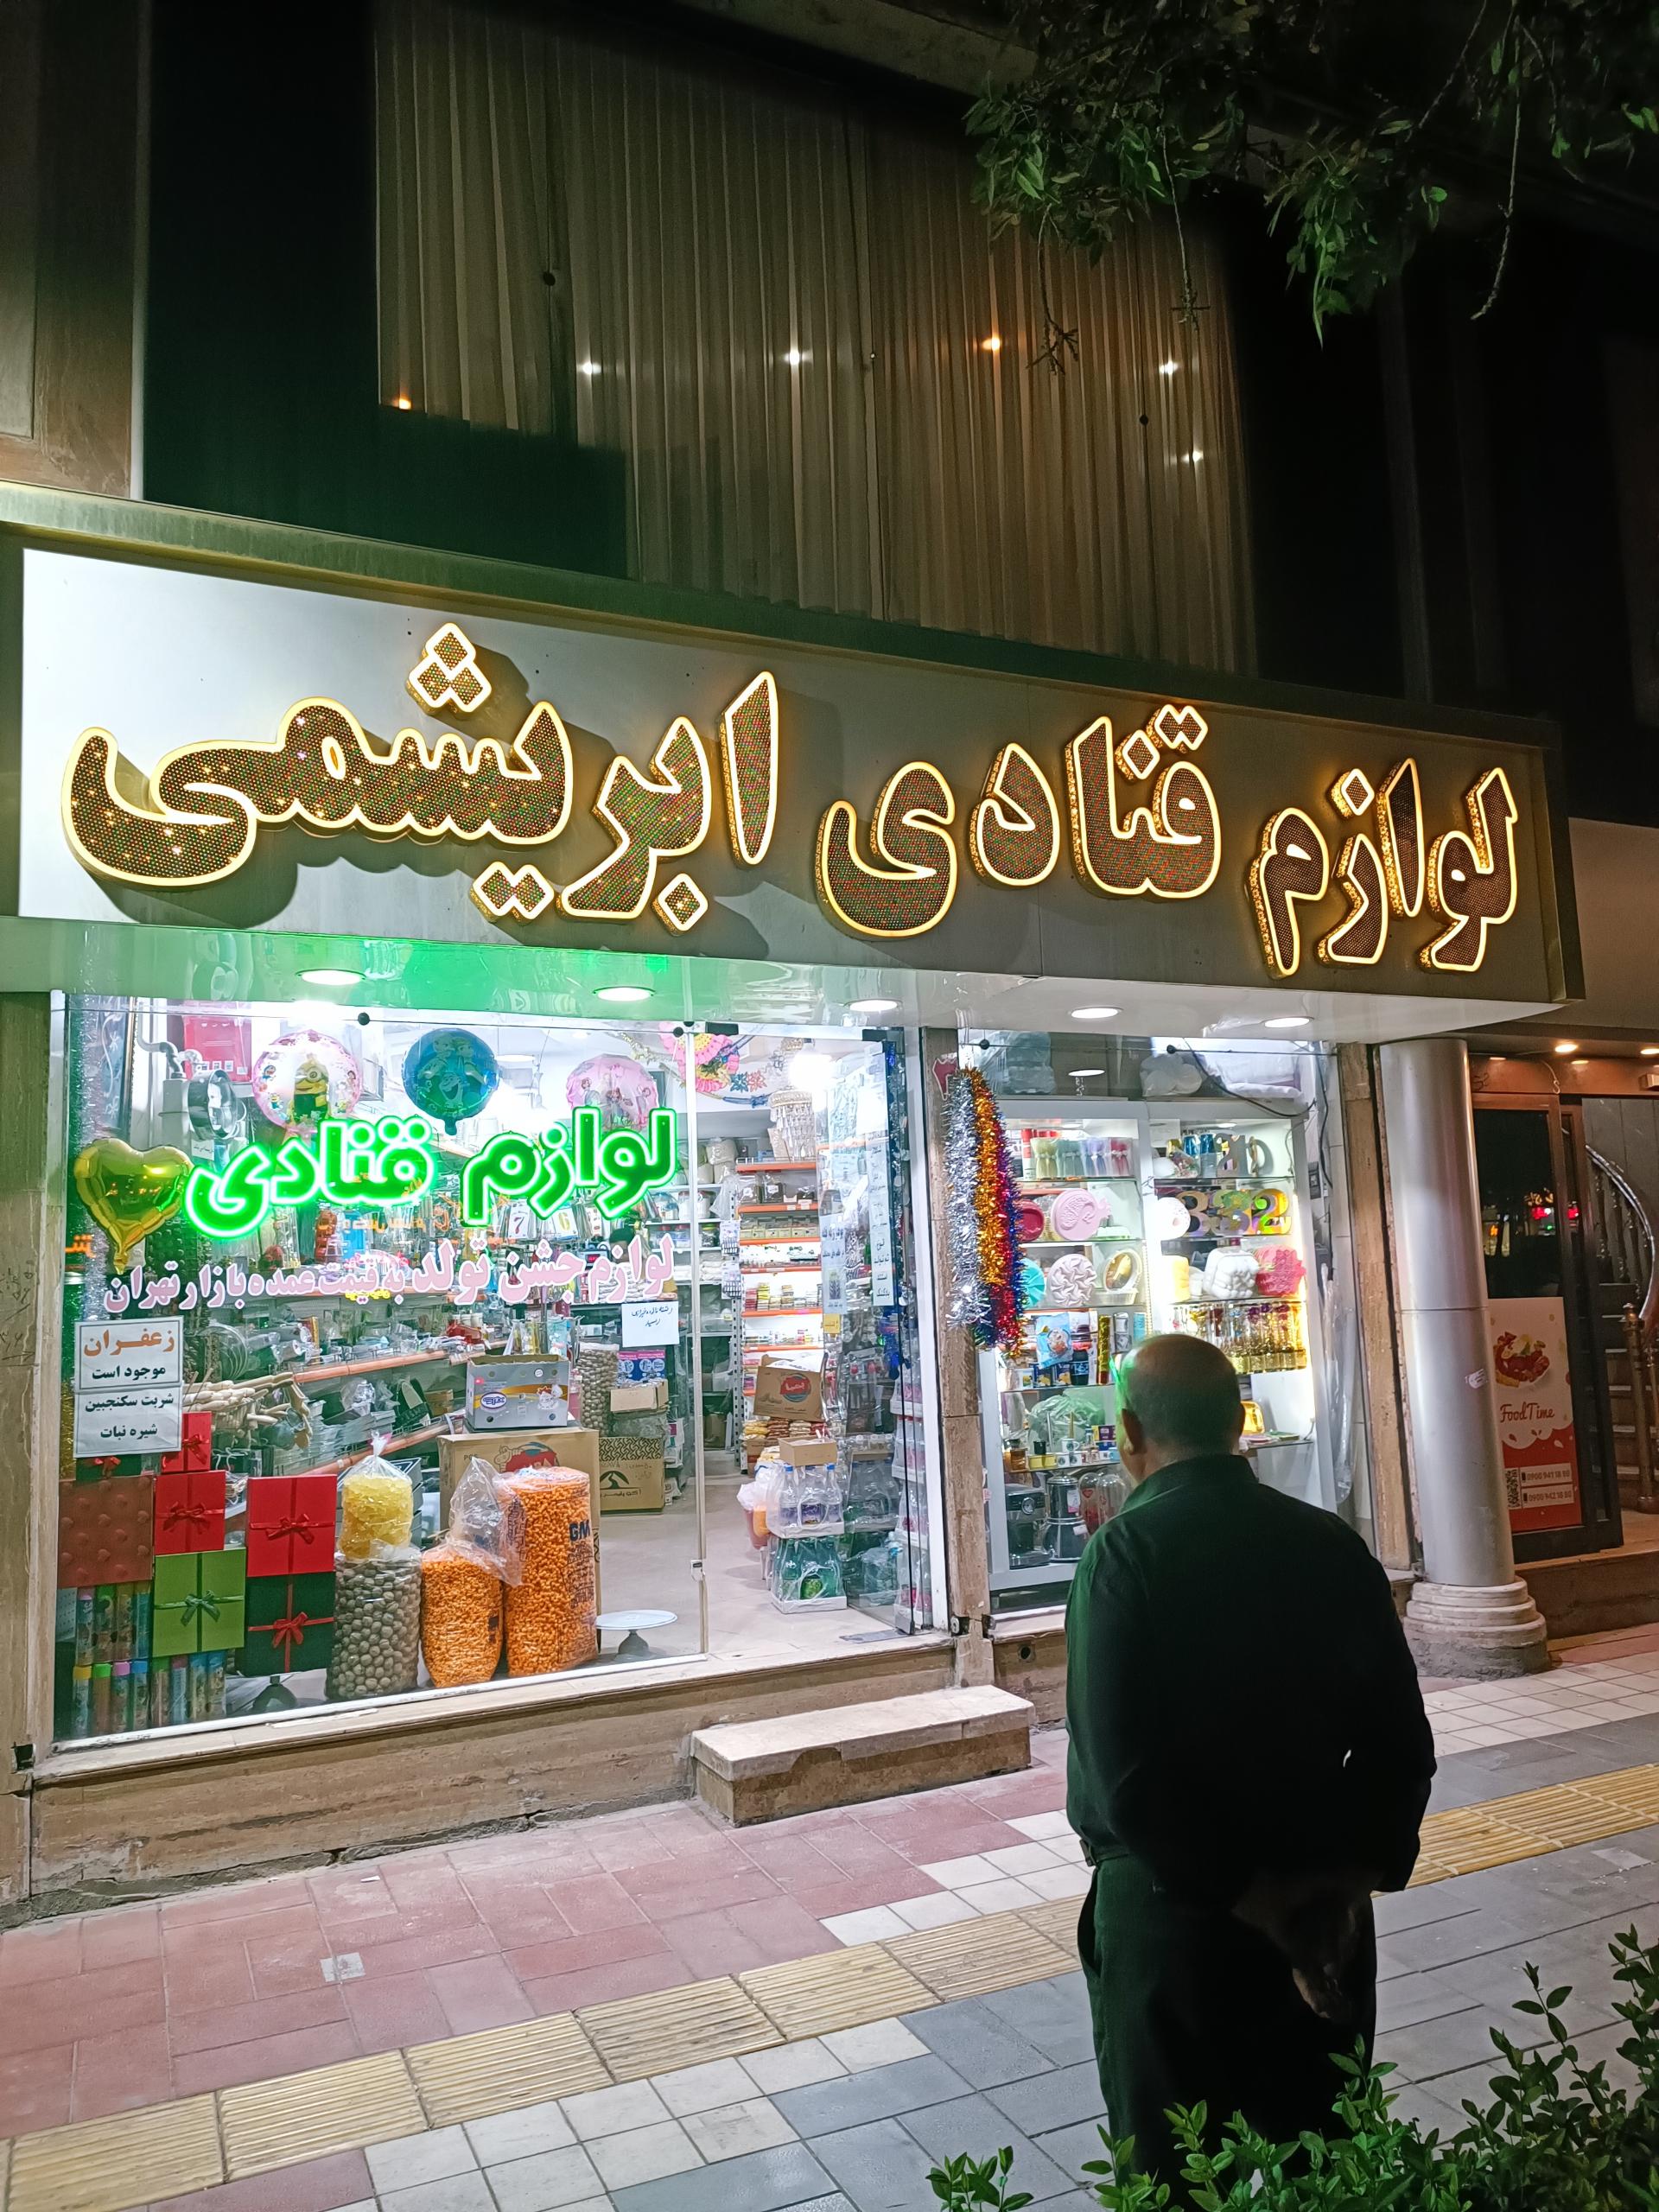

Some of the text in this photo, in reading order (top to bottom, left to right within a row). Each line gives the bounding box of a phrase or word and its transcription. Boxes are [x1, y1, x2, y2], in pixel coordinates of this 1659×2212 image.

[61, 621, 1519, 980] لوازم قنادی ابریشمی
[184, 1106, 677, 1238] لوازم قنادی
[103, 1233, 674, 1313] لوازم جشن تولد به قیمت عمده بازار تهران
[84, 1328, 175, 1357] زعفران
[92, 1365, 166, 1380] موجود است
[85, 1393, 174, 1412] شربت سکنجبین
[100, 1424, 158, 1440] شیره نبات
